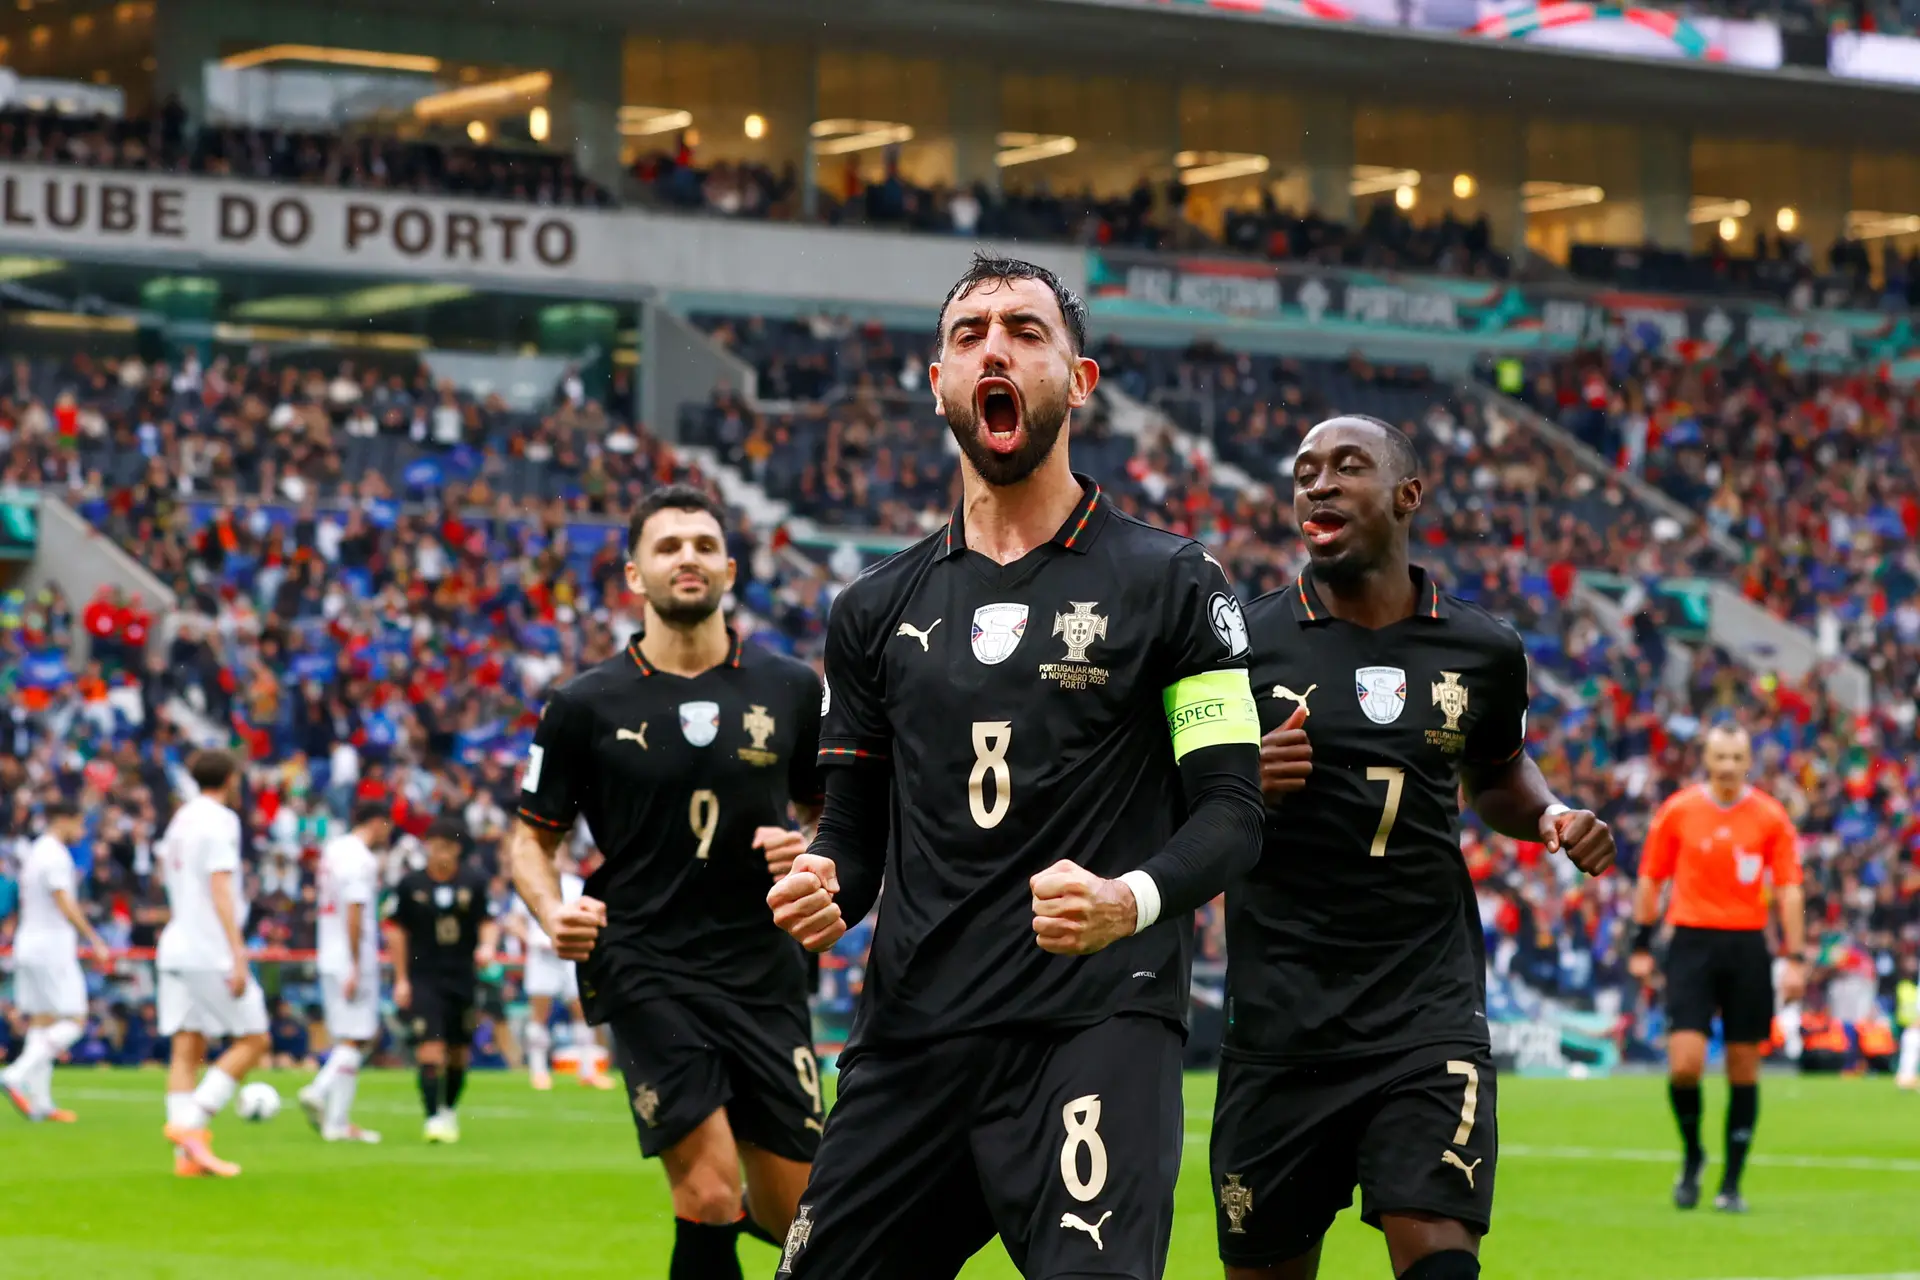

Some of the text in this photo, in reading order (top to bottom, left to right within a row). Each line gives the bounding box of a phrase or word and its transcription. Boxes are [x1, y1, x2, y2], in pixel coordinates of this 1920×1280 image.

[218, 194, 314, 247] DO
[344, 204, 578, 267] PORTO
[1060, 681, 1087, 690] PORTO
[968, 721, 1012, 830] 8
[1366, 766, 1405, 857] 7
[689, 789, 719, 859] 9
[793, 1046, 821, 1113] 9
[1446, 1060, 1479, 1146] 7
[1060, 1094, 1108, 1202] 8
